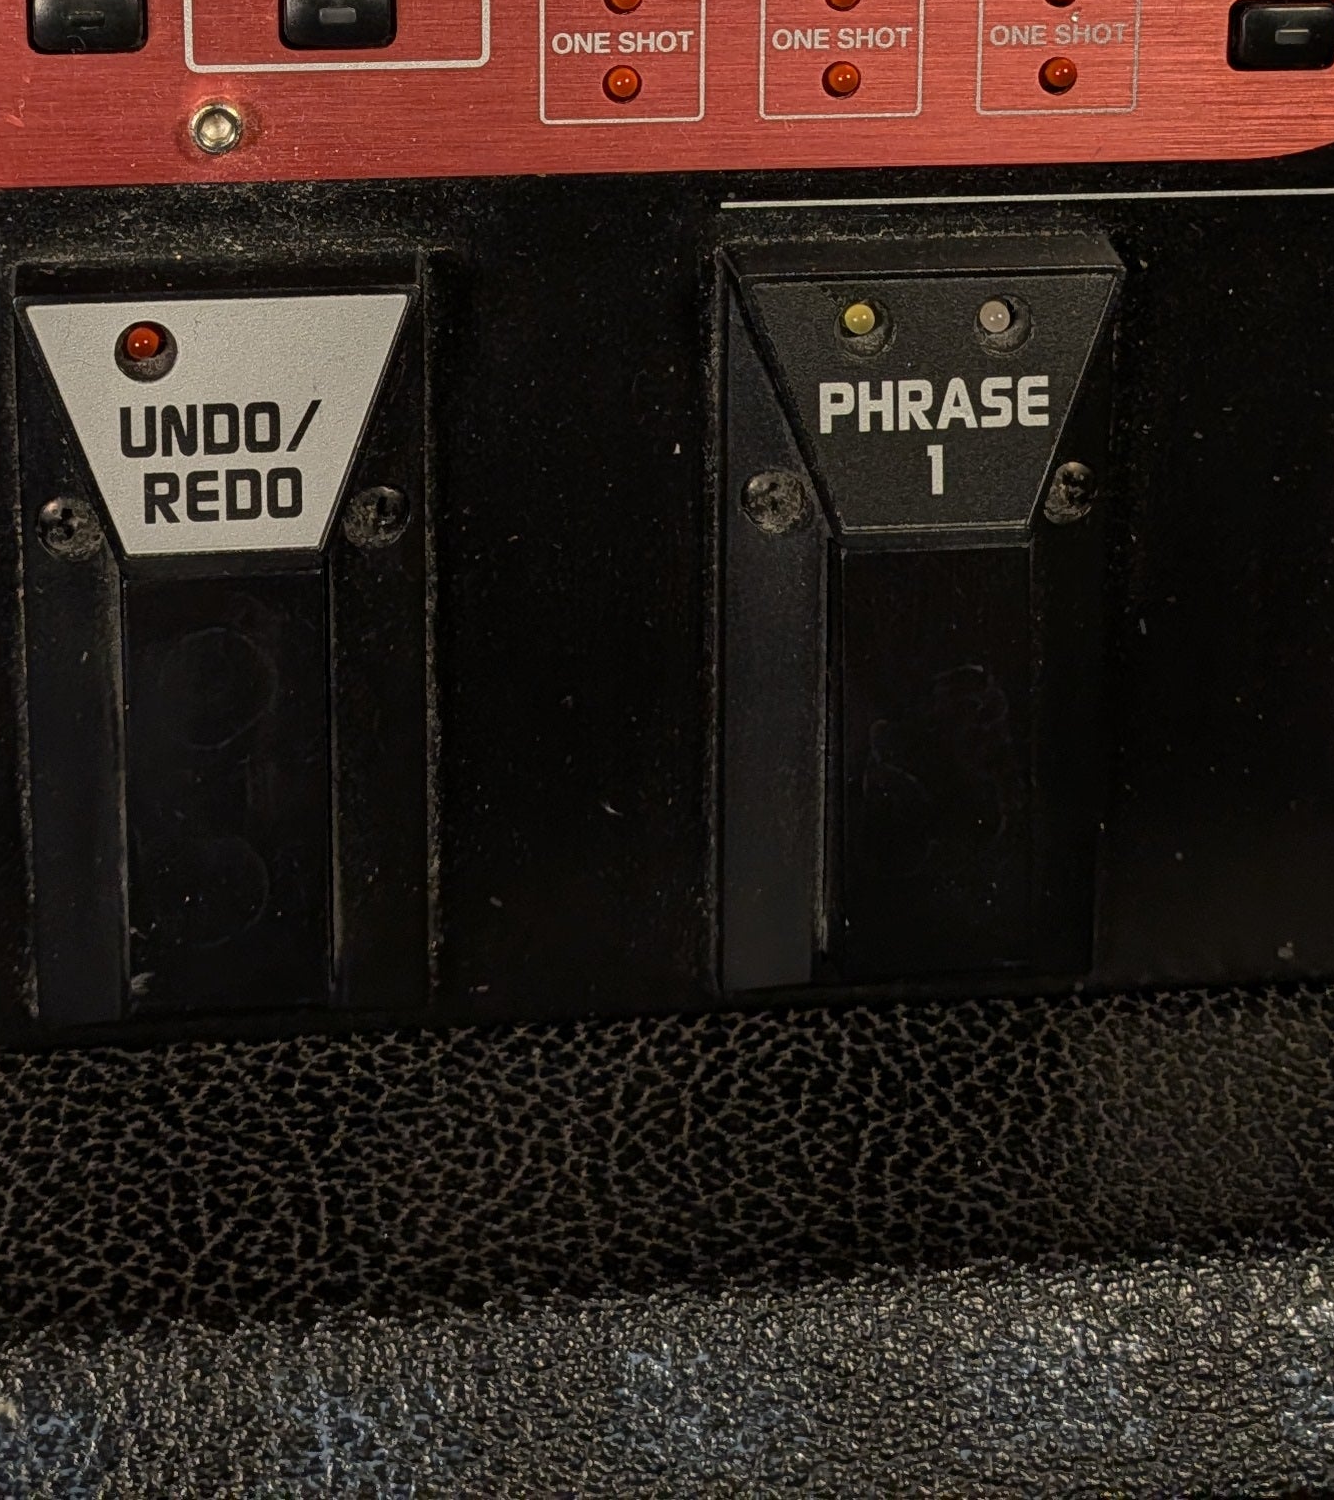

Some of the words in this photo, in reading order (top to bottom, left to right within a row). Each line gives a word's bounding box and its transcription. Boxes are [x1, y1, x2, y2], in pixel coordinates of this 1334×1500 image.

[552, 34, 610, 54] ONE
[621, 32, 694, 53] SHOT
[772, 30, 830, 51] ONE
[839, 28, 913, 49] SHOT
[989, 26, 1047, 47] ONE
[1056, 23, 1129, 45] SHOT
[118, 399, 322, 459] UNDO/
[819, 375, 1050, 434] PHRASE
[925, 444, 946, 495] 1
[143, 467, 302, 526] REDO
